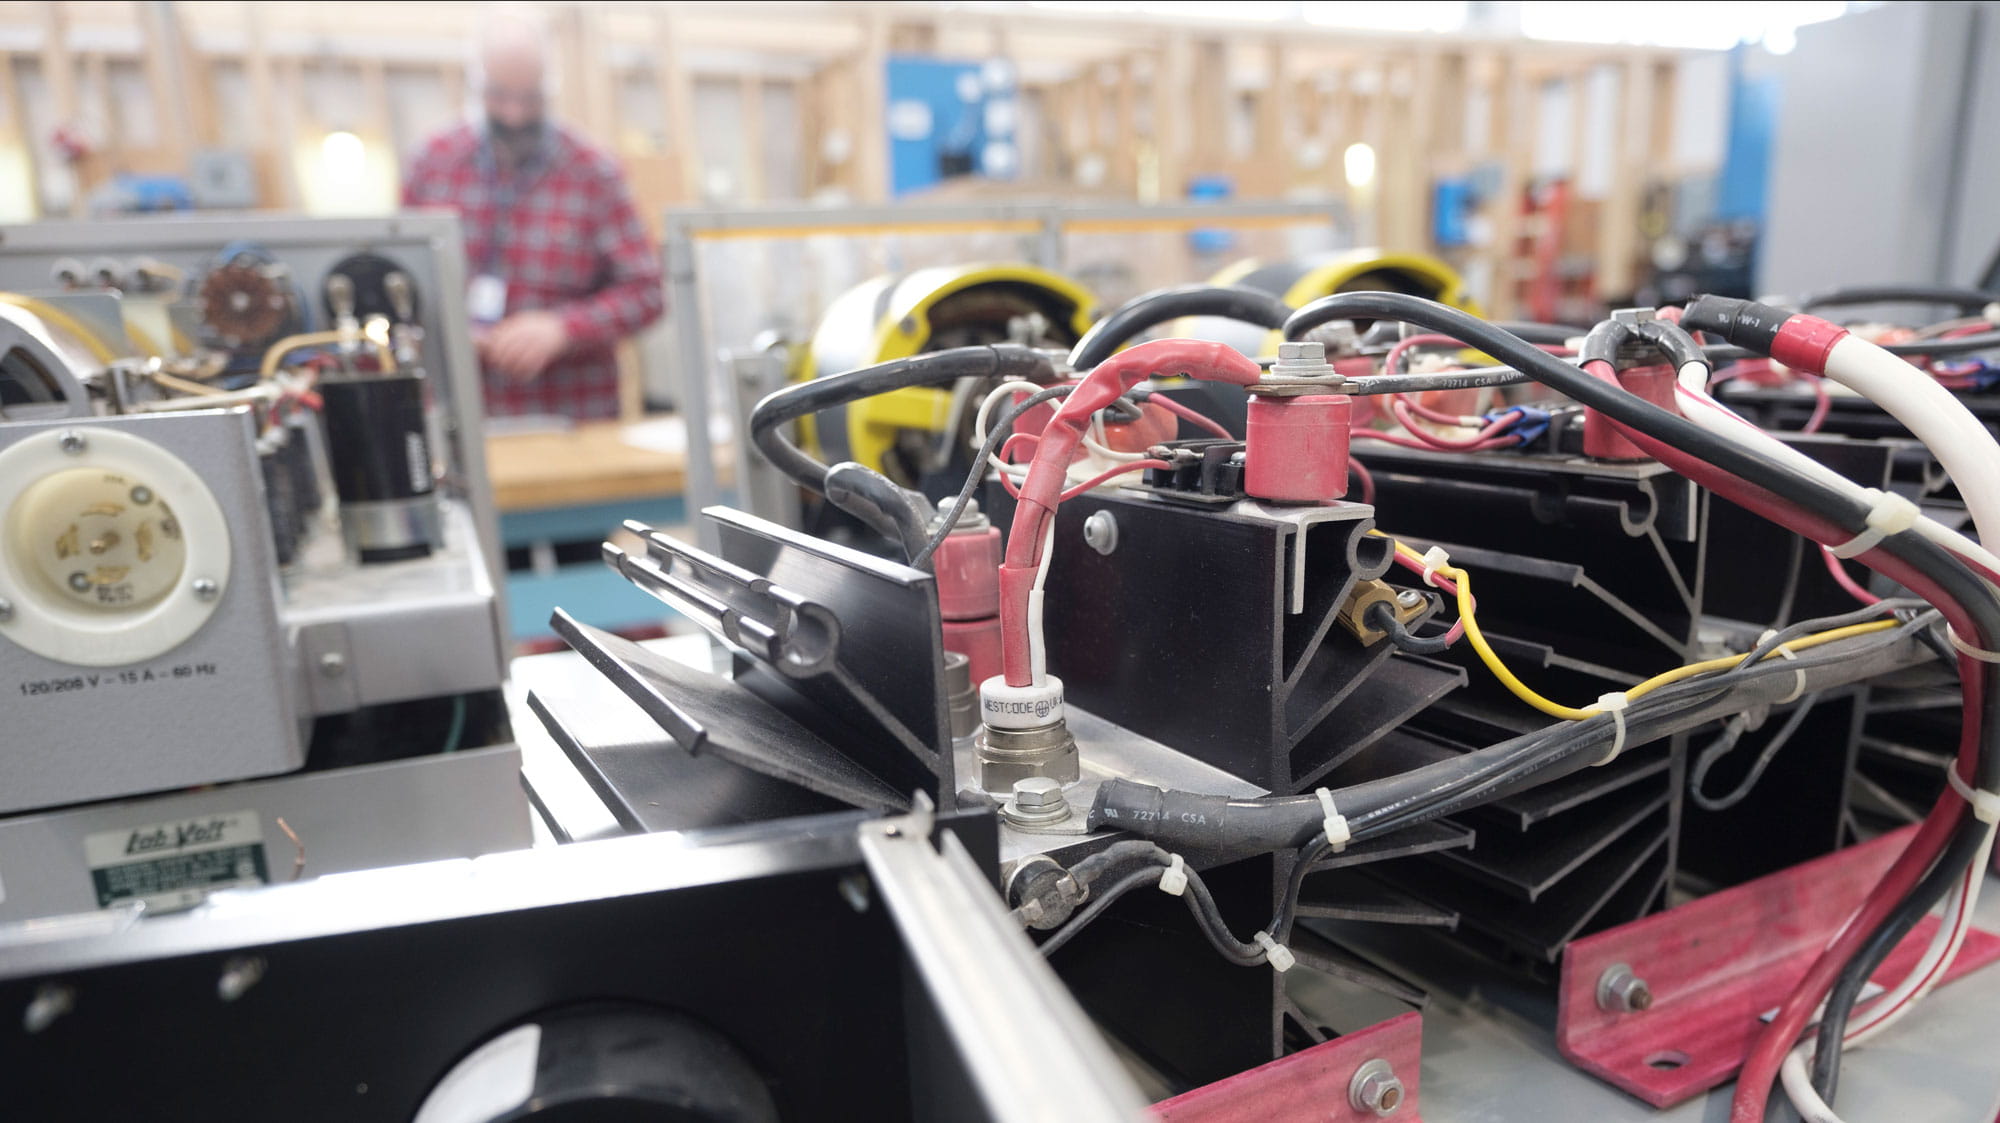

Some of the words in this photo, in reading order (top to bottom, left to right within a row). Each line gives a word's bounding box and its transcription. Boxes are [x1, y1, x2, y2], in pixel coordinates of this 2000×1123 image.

[1475, 378, 1492, 386] CSA
[20, 677, 84, 696] 120/208
[87, 674, 99, 688] V
[118, 671, 138, 685] 15
[143, 669, 154, 682] A
[196, 663, 216, 676] Hz
[1133, 810, 1170, 822] 72714
[1181, 812, 1206, 825] CSA
